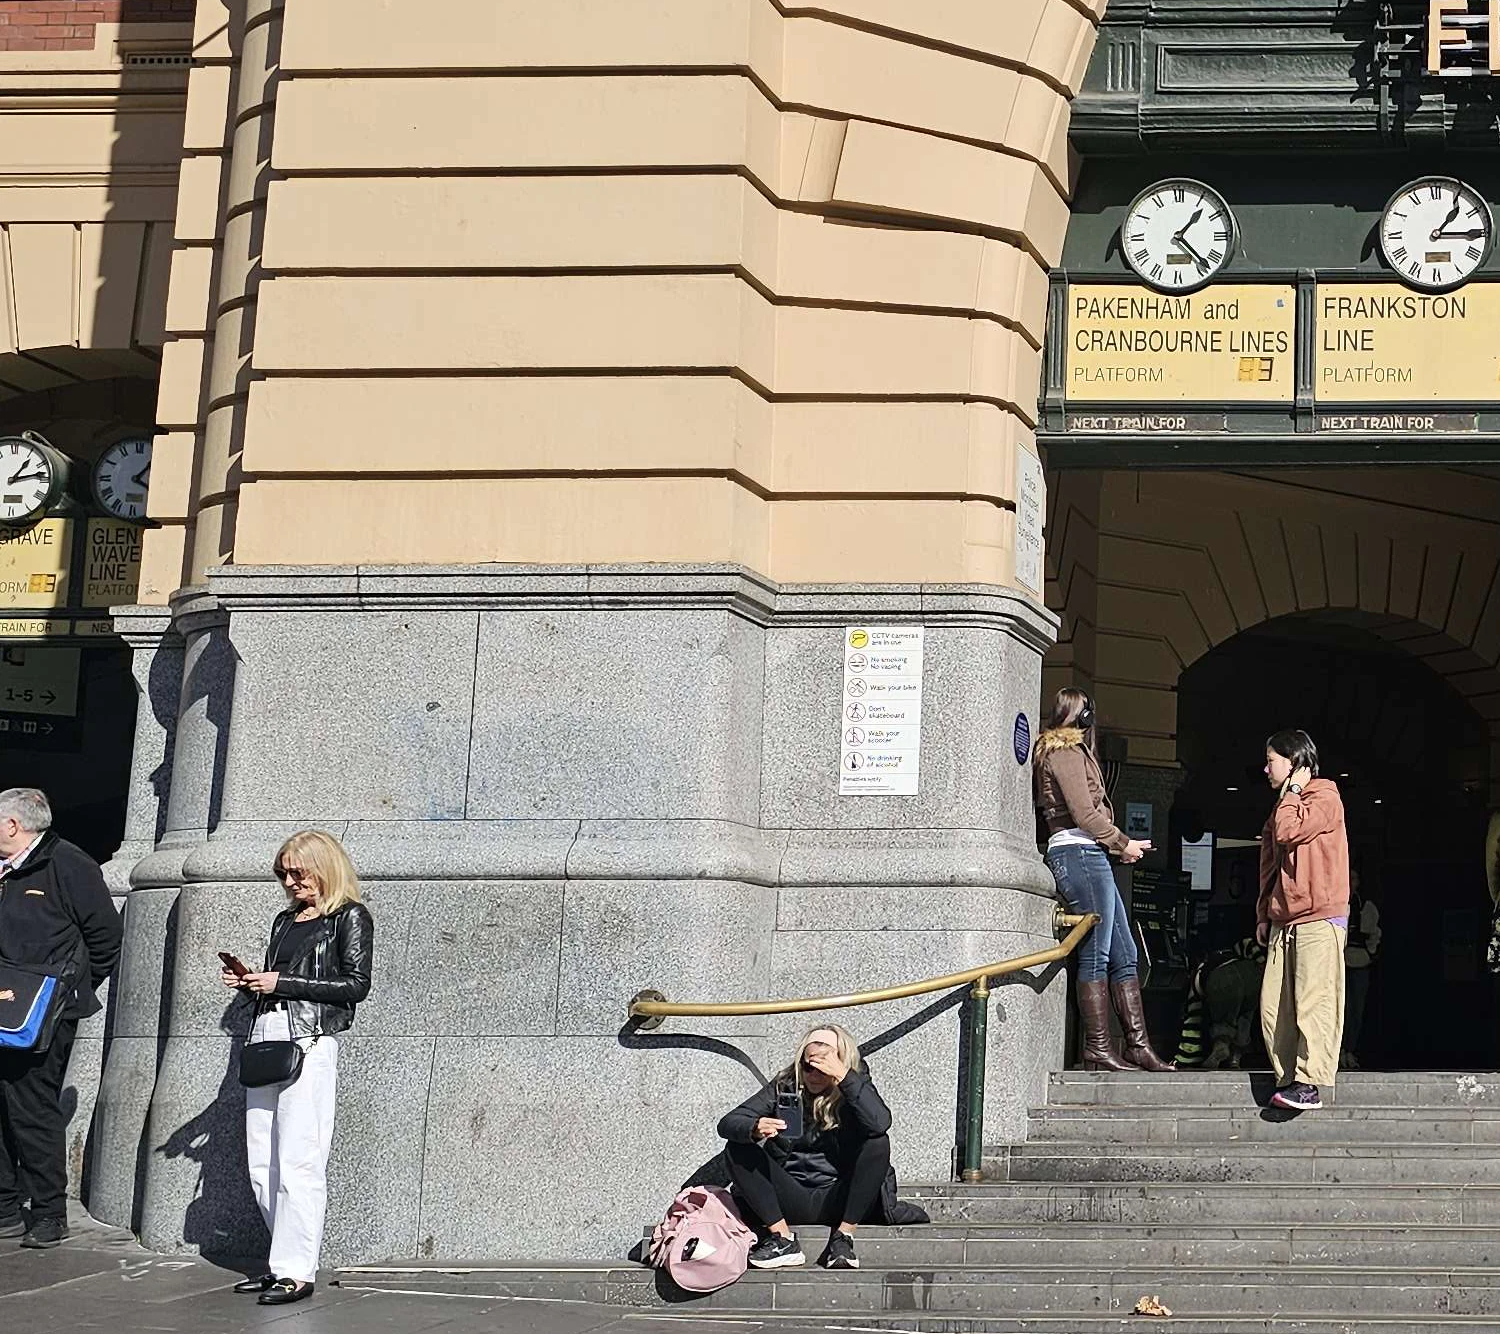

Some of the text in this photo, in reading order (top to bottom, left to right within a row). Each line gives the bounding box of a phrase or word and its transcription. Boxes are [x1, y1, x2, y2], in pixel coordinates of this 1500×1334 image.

[1076, 297, 1239, 320] PAKENHAM and
[1324, 297, 1466, 319] FRANKSTON
[1075, 330, 1288, 353] CRANBOURNE LINES
[1324, 330, 1374, 351] LINE
[1074, 368, 1163, 382] PLATFORM
[1323, 368, 1412, 383] PLATFORM
[1073, 417, 1186, 430] NEXT TRAIN FOR
[1321, 417, 1434, 429] NEXT TRAIN FOR
[93, 528, 137, 545] GLEN
[93, 546, 140, 563] WAVE
[90, 564, 126, 581] LINE
[88, 584, 138, 596] PLATFO
[30, 623, 52, 632] FOR
[6, 688, 33, 701] 1-5
